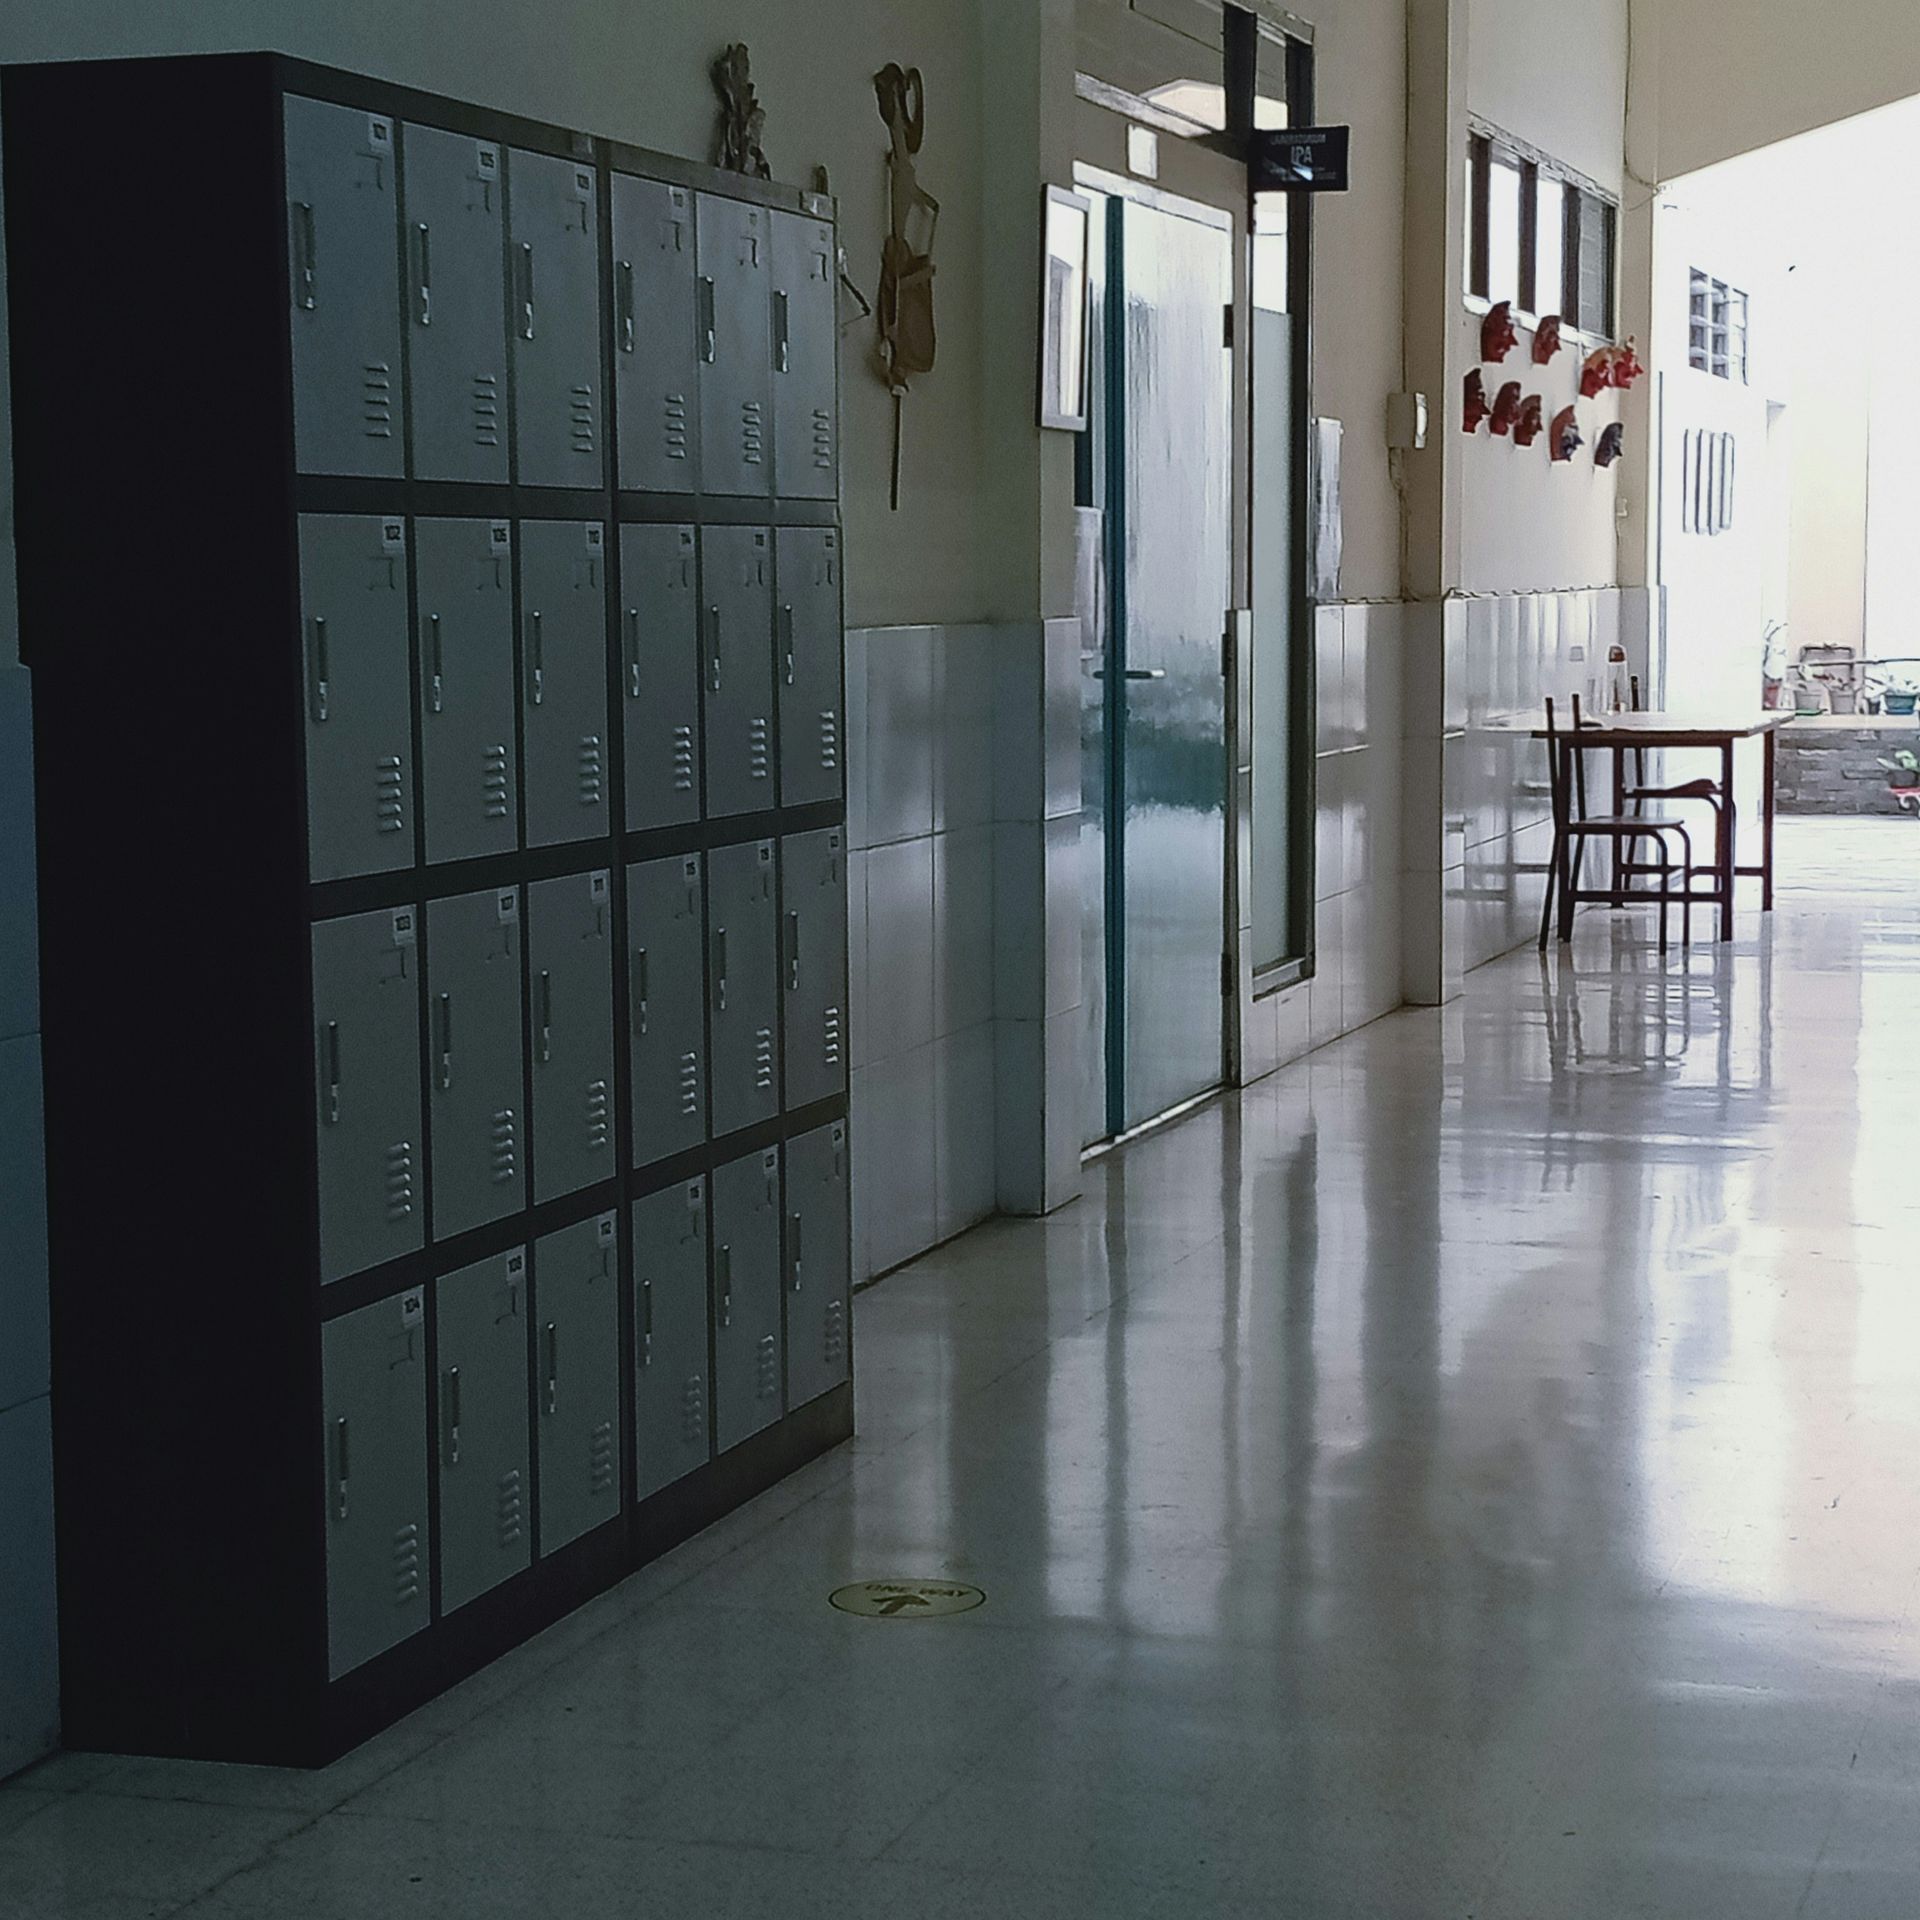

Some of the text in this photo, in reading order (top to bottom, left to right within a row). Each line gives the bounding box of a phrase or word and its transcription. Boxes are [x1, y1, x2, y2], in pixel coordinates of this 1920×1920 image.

[1291, 146, 1313, 164] IPA
[385, 525, 401, 541] 102
[405, 1297, 420, 1314] 104
[865, 1584, 912, 1593] ONE
